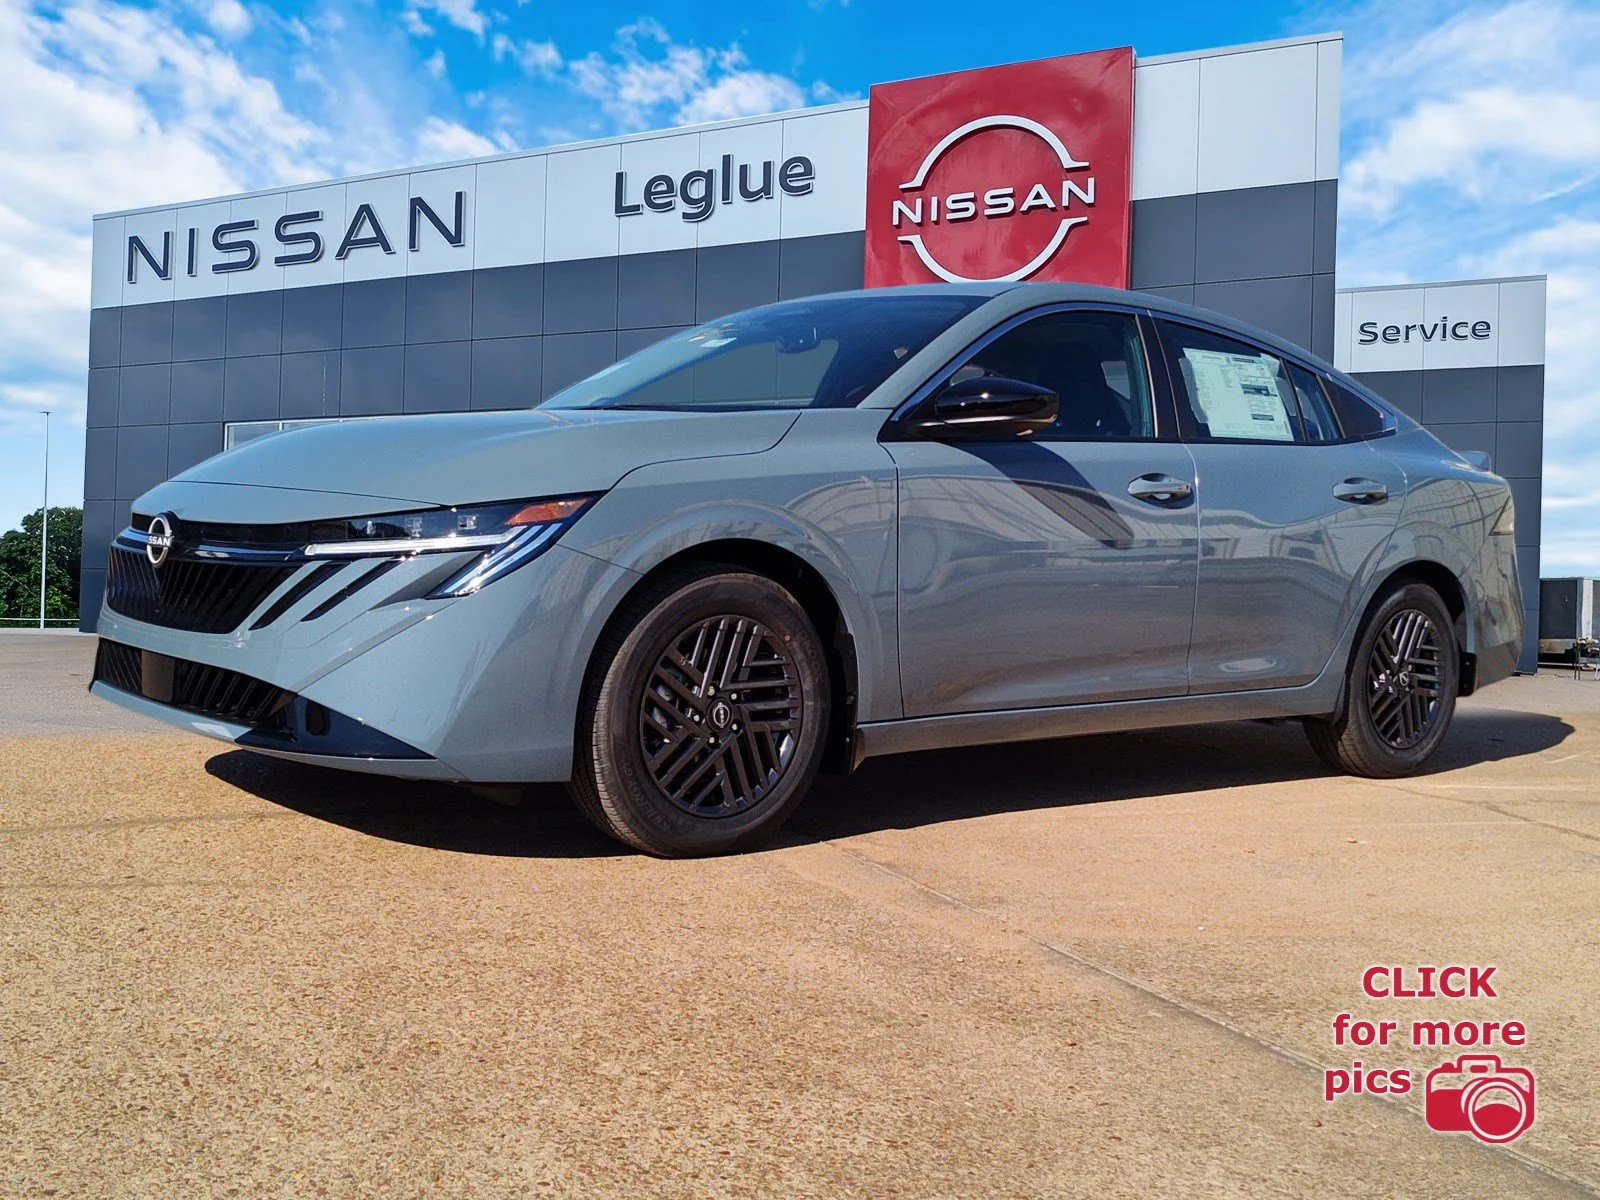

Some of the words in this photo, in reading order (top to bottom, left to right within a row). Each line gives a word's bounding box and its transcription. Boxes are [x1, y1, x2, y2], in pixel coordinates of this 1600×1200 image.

[614, 153, 815, 222] Leglue
[892, 177, 1096, 226] NISSAN
[127, 190, 465, 284] NISSAN
[1358, 315, 1492, 345] Service
